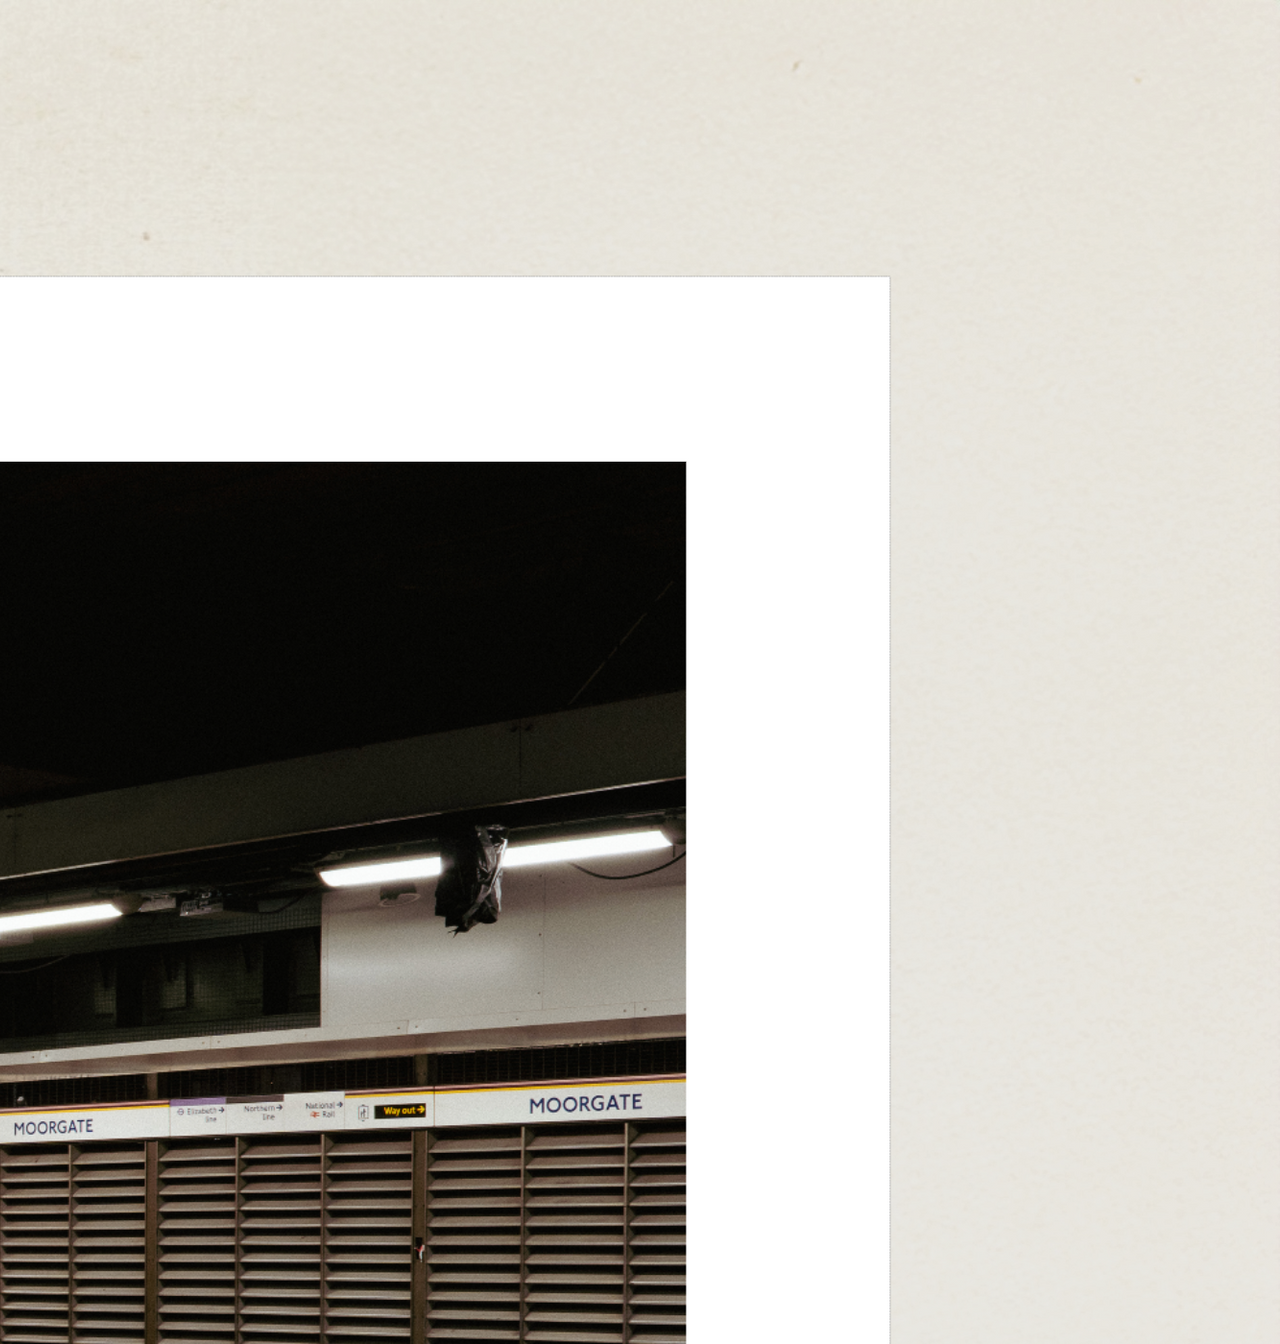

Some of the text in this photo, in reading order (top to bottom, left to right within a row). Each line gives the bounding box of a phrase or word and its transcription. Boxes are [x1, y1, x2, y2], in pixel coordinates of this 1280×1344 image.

[529, 1093, 643, 1114] MOORGATE
[187, 1107, 217, 1115] Elizabeth
[243, 1105, 276, 1113] Northern
[383, 1106, 416, 1117] Way out
[262, 1113, 276, 1121] line
[322, 1110, 336, 1118] Rail
[13, 1118, 94, 1136] MOORGATE
